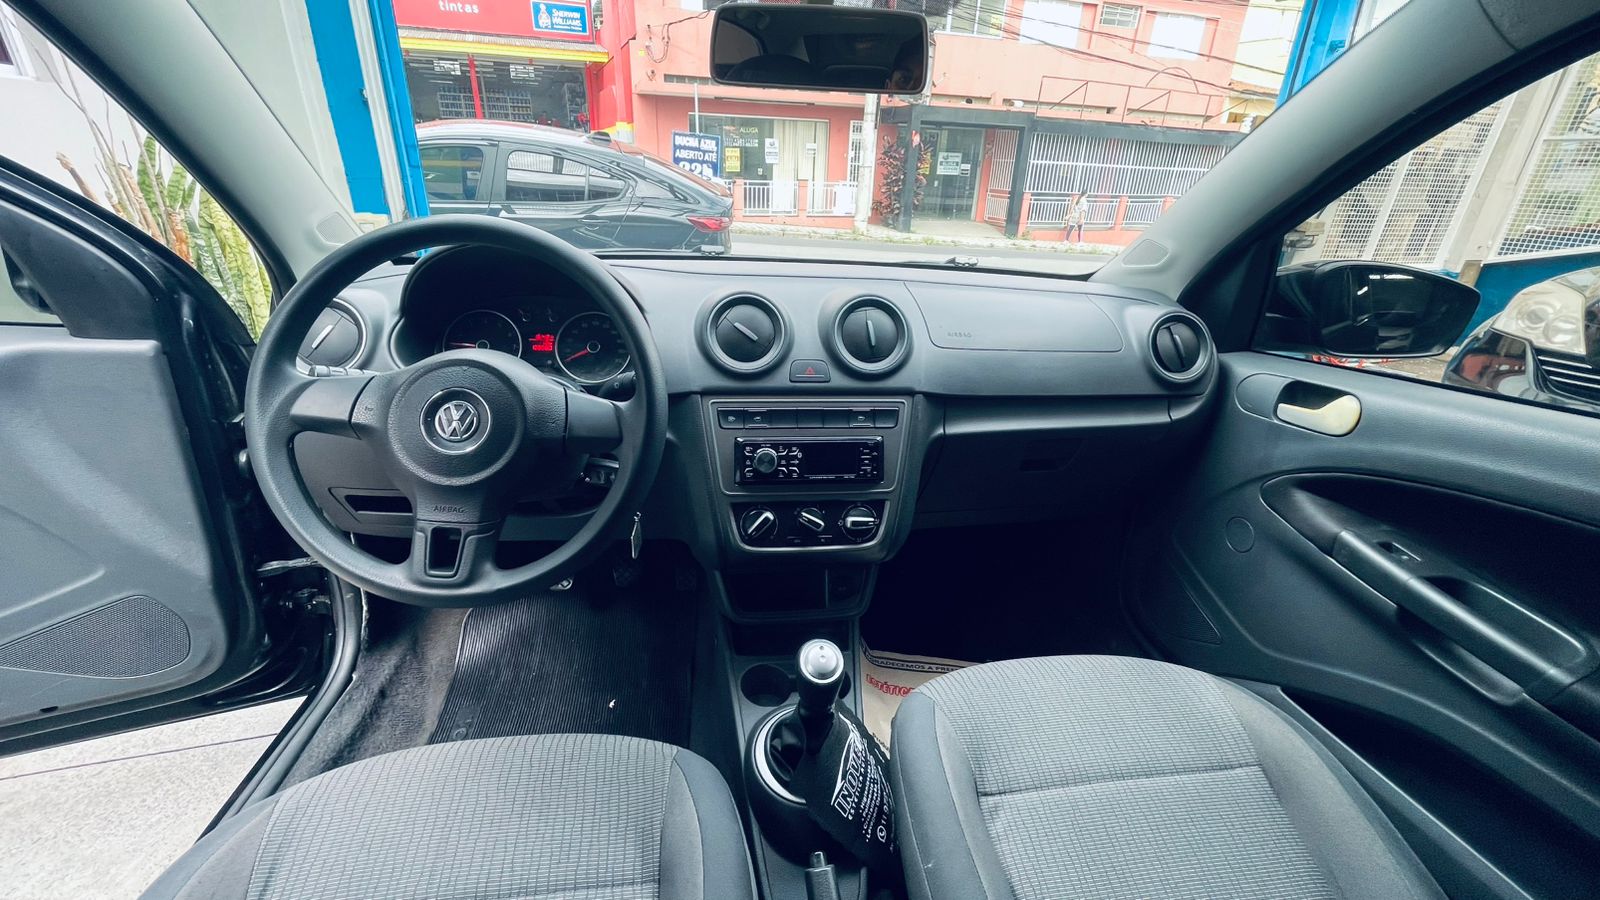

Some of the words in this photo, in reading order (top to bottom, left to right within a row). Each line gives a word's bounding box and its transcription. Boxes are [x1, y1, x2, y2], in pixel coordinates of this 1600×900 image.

[438, 0, 479, 14] tintas
[552, 8, 581, 19] SHERWIN
[674, 135, 699, 148] DUCHA
[674, 149, 704, 161] ABERTO
[704, 151, 717, 162] ATÉ
[434, 504, 466, 515] AIRBAG
